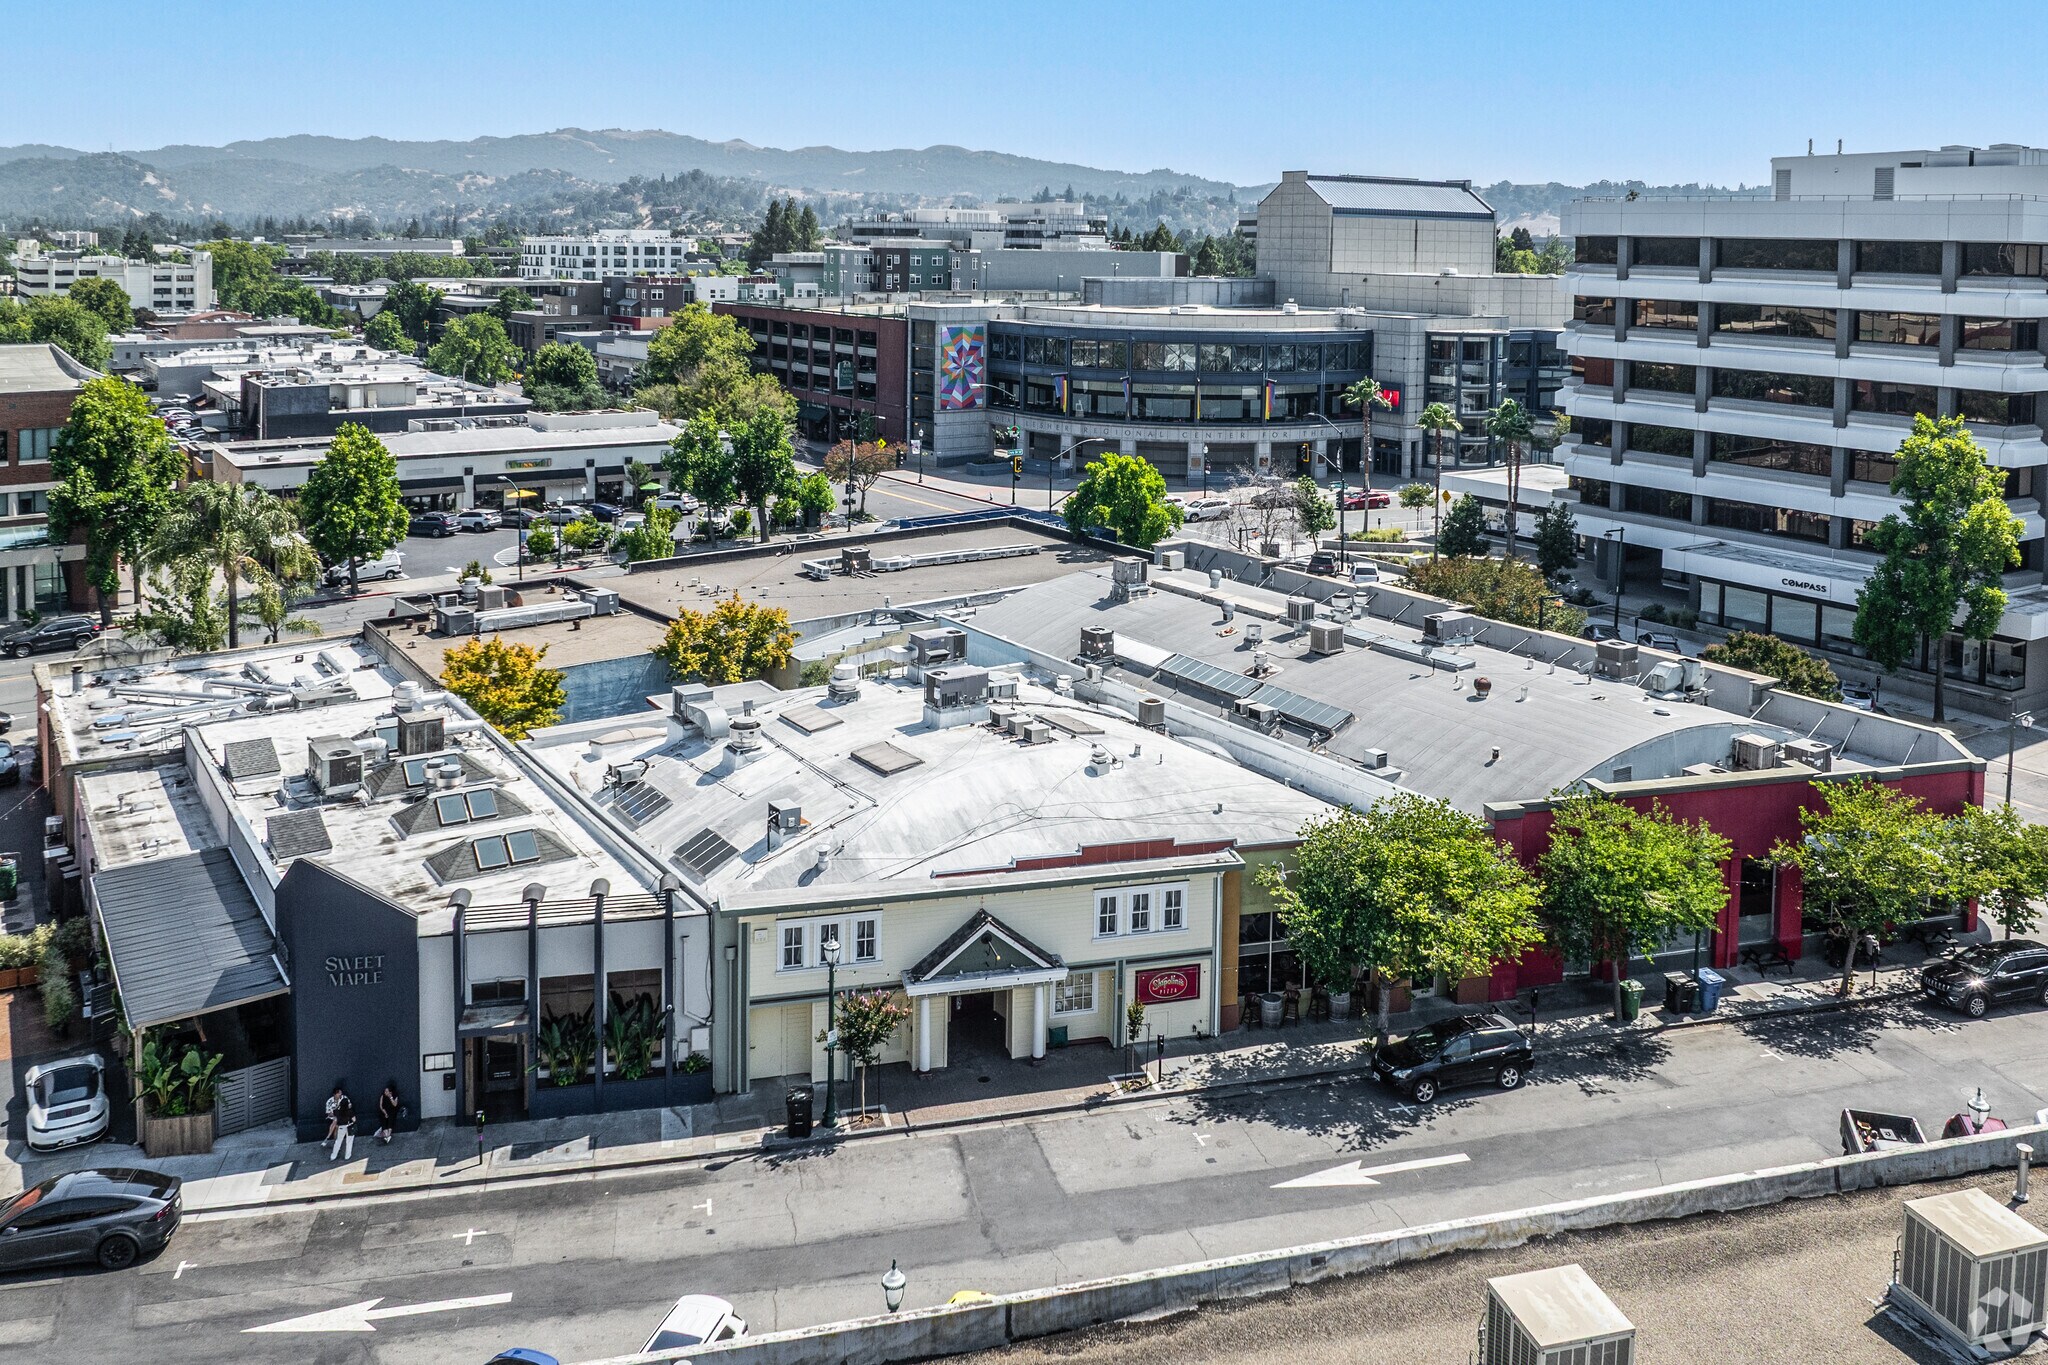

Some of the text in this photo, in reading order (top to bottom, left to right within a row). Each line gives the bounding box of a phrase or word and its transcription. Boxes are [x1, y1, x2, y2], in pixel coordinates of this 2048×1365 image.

[1025, 421, 1072, 432] LESHER
[1083, 427, 1165, 438] REGIONAL
[1181, 431, 1246, 439] CENTER
[1262, 431, 1288, 439] FOR
[1303, 429, 1324, 437] THE
[1782, 578, 1827, 593] COMPASS
[325, 955, 385, 971] SWEET
[329, 971, 383, 987] MAPLE
[1159, 987, 1177, 995] PIZZA
